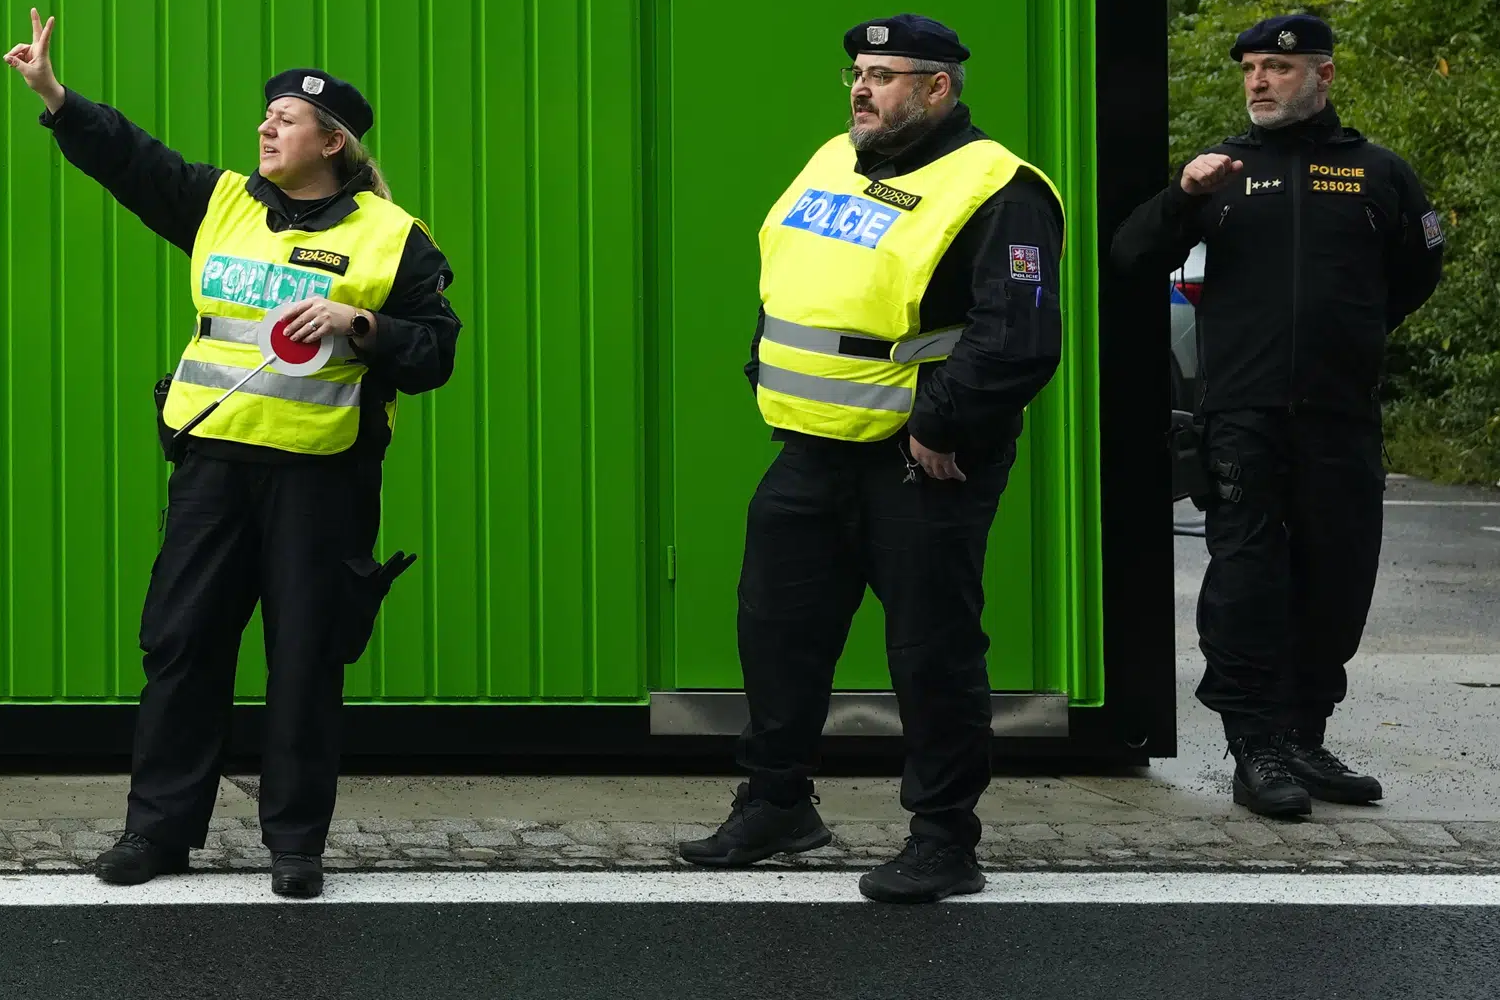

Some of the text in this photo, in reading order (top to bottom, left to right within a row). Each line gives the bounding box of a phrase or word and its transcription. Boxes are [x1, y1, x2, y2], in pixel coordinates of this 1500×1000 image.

[1309, 164, 1365, 178] POLICIE
[868, 183, 917, 207] 302880
[1312, 180, 1361, 193] 235023
[788, 195, 892, 240] POLICIE
[297, 249, 343, 266] 324266
